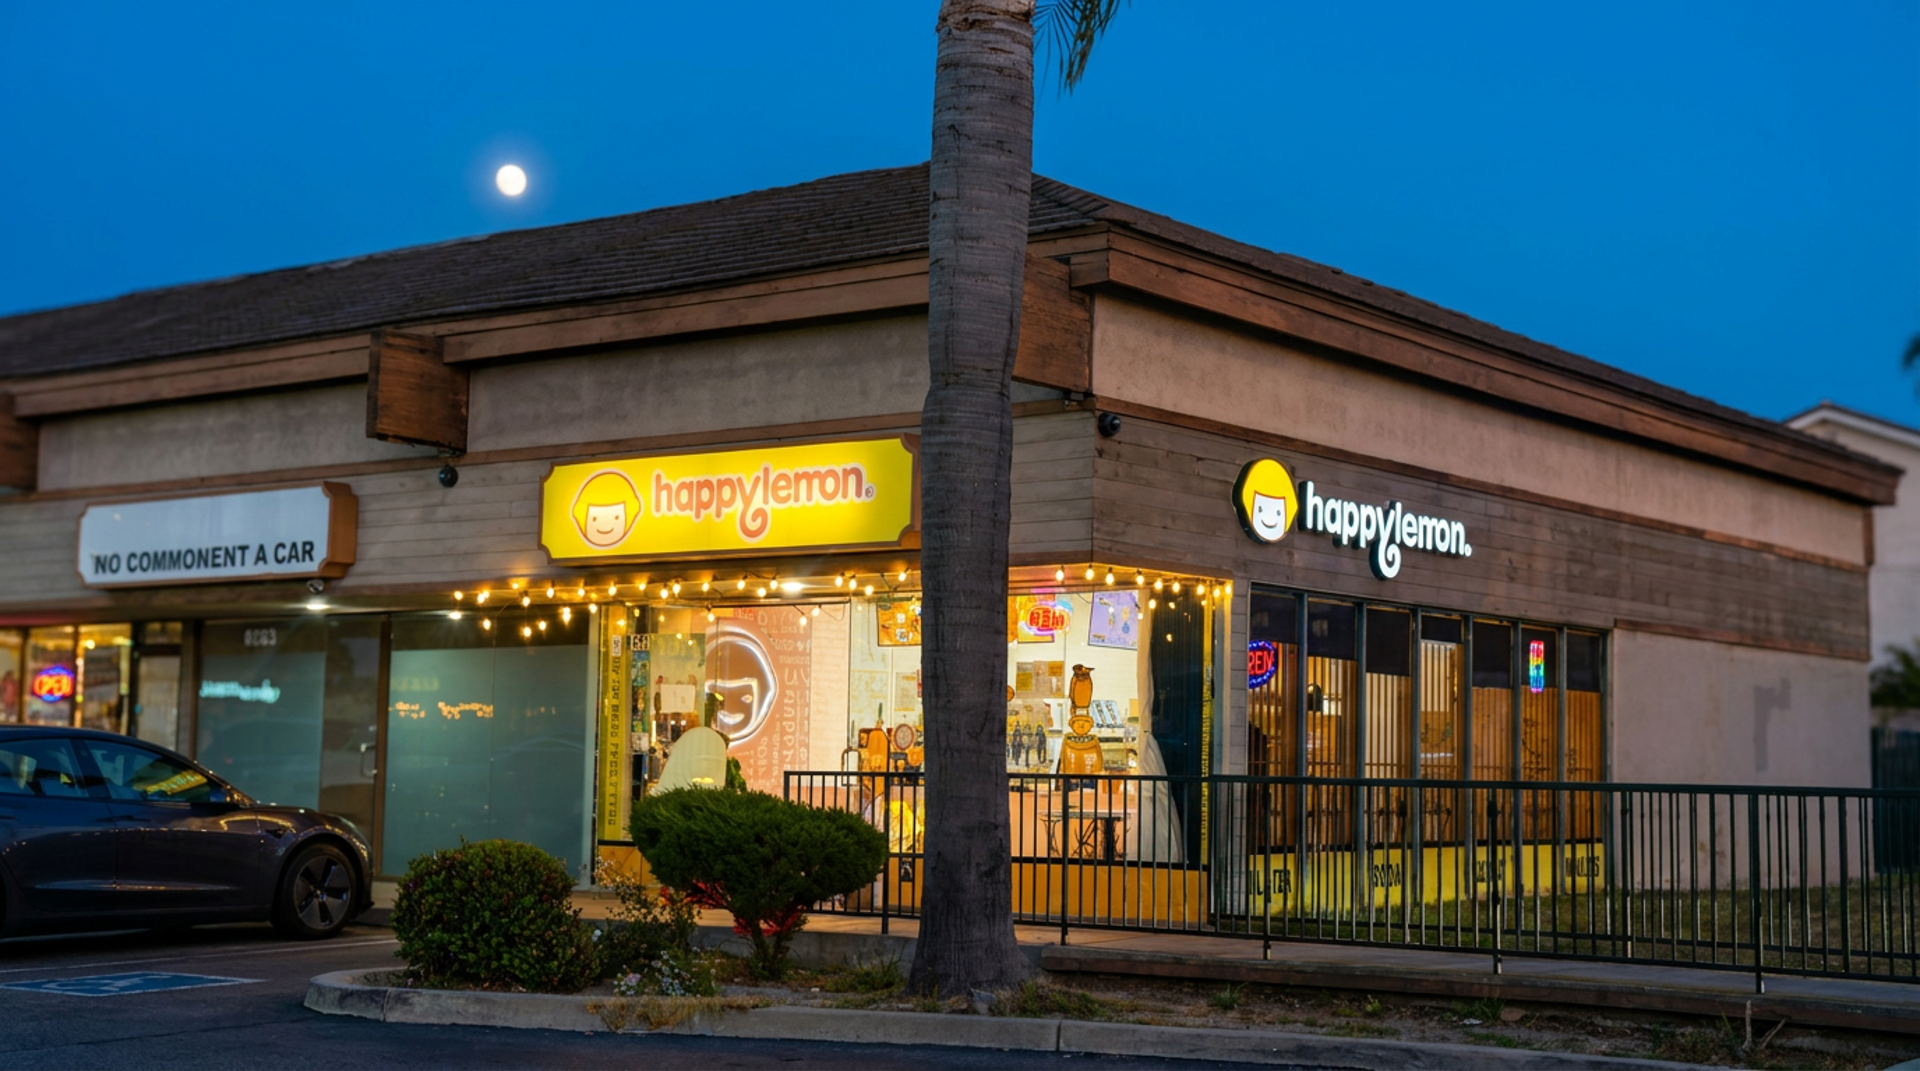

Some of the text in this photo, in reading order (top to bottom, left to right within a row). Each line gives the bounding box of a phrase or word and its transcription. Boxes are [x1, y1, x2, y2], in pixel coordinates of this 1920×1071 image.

[94, 540, 315, 574] NO COMMONENT A CAR
